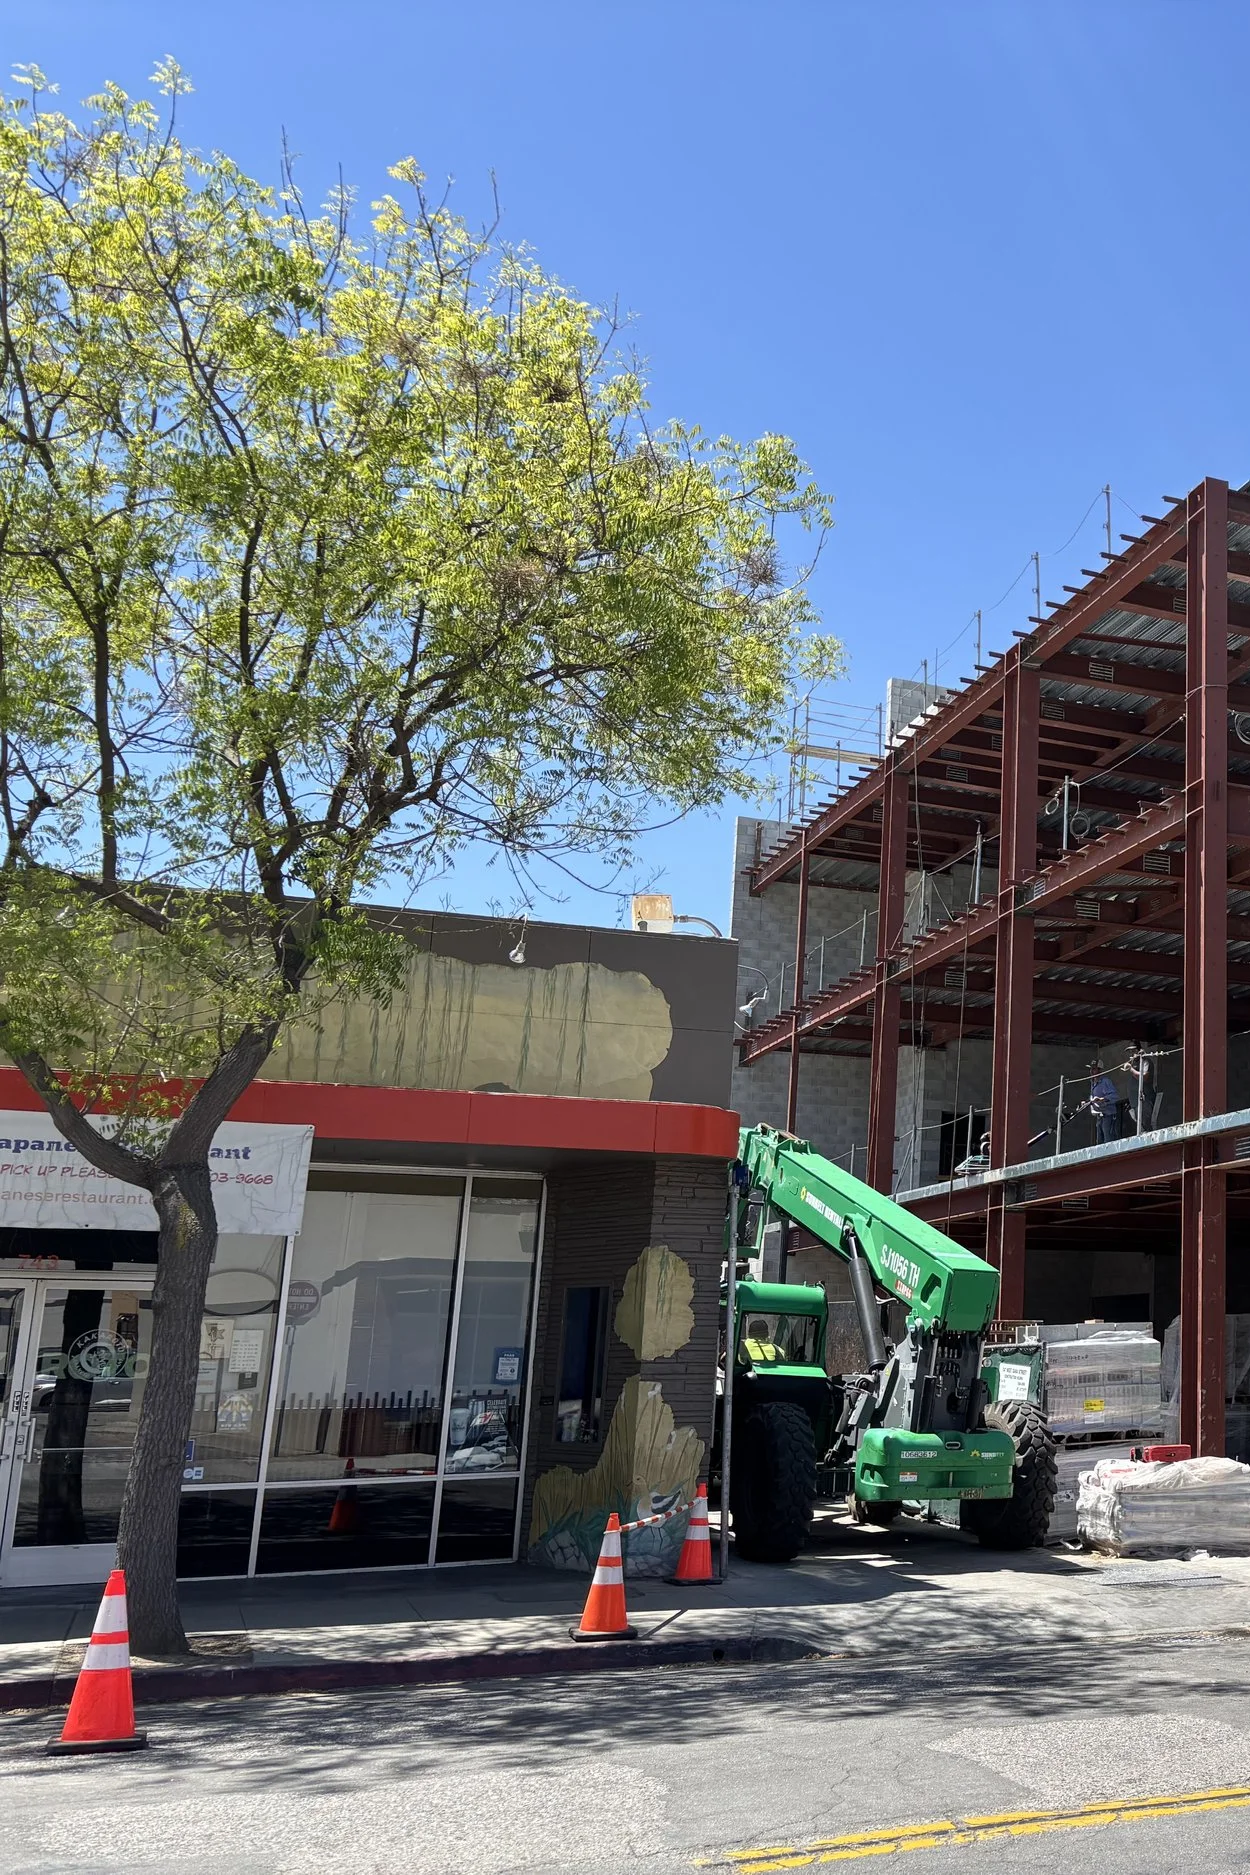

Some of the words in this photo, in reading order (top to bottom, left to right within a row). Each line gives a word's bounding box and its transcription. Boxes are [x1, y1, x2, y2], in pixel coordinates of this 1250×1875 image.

[0, 1163, 34, 1176] PICK
[37, 1165, 58, 1177] UP
[209, 1172, 274, 1185] 03-9668
[18, 1254, 59, 1270] 743
[880, 1243, 910, 1281] SJ1056
[908, 1261, 921, 1290] TH
